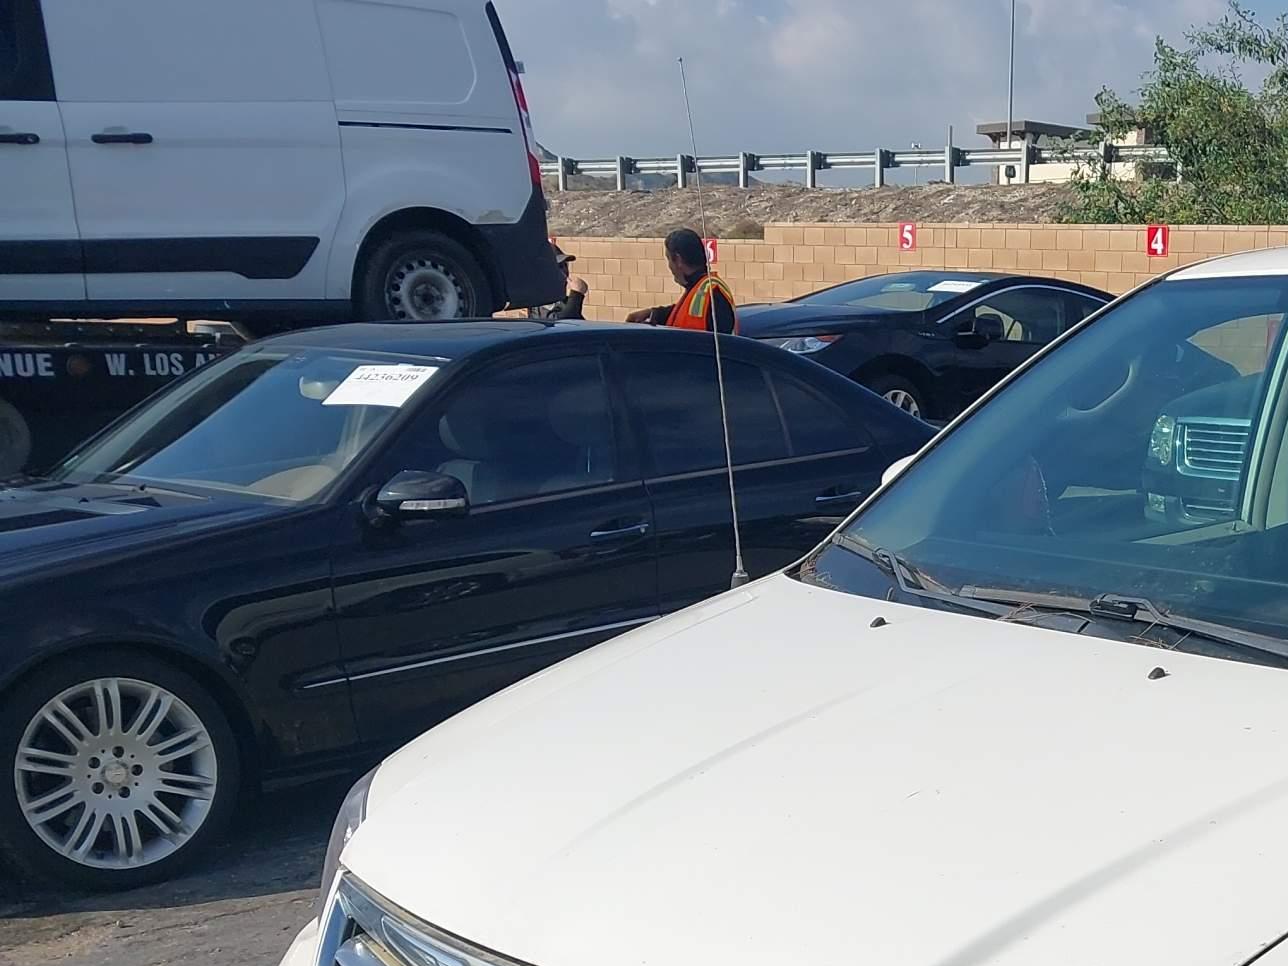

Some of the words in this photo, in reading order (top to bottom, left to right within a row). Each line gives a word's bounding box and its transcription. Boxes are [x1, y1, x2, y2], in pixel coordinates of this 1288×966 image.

[902, 224, 913, 249] 5
[1150, 227, 1164, 255] 4
[105, 353, 134, 376] W.
[144, 353, 184, 376] LOS
